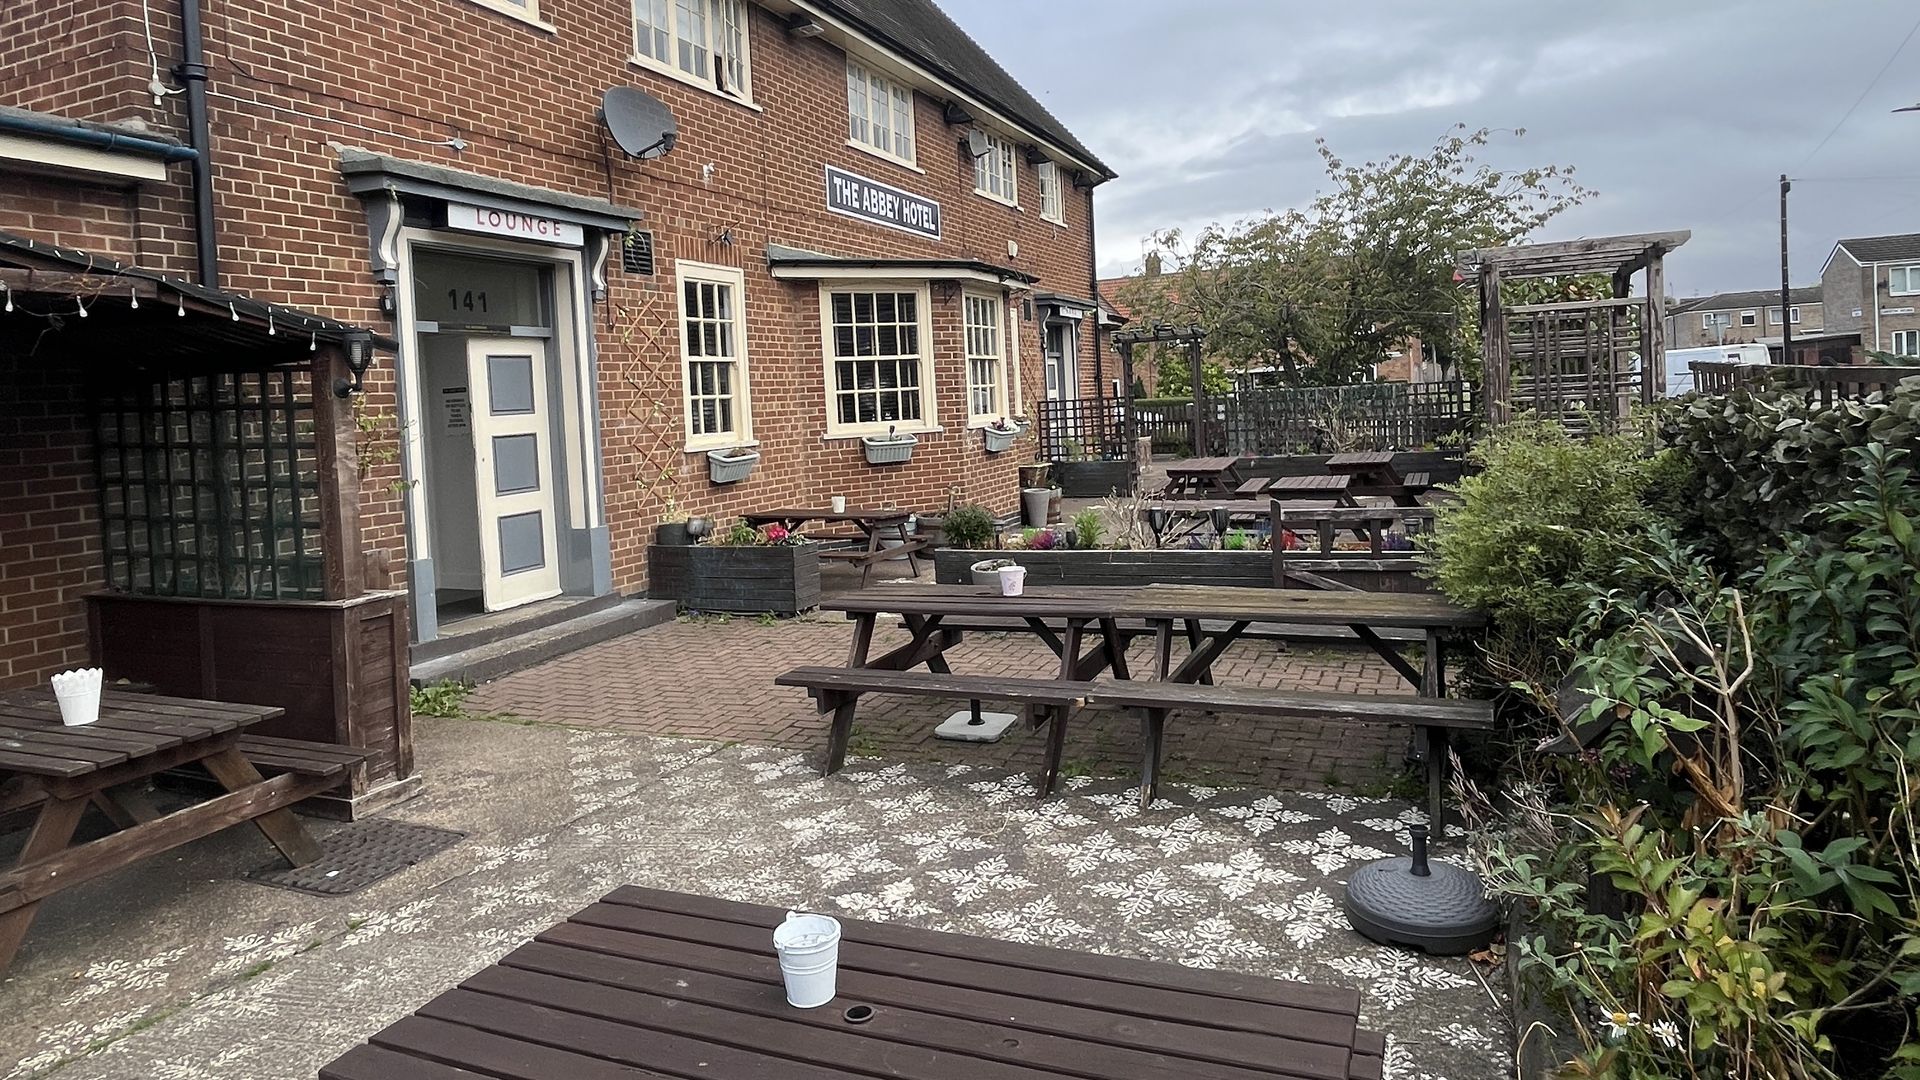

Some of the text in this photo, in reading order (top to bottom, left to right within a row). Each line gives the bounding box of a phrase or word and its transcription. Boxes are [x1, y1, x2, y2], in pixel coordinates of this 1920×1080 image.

[834, 176, 935, 230] THE ABBEY HOTEL
[476, 208, 560, 236] LOUNGE
[448, 289, 487, 312] 141
